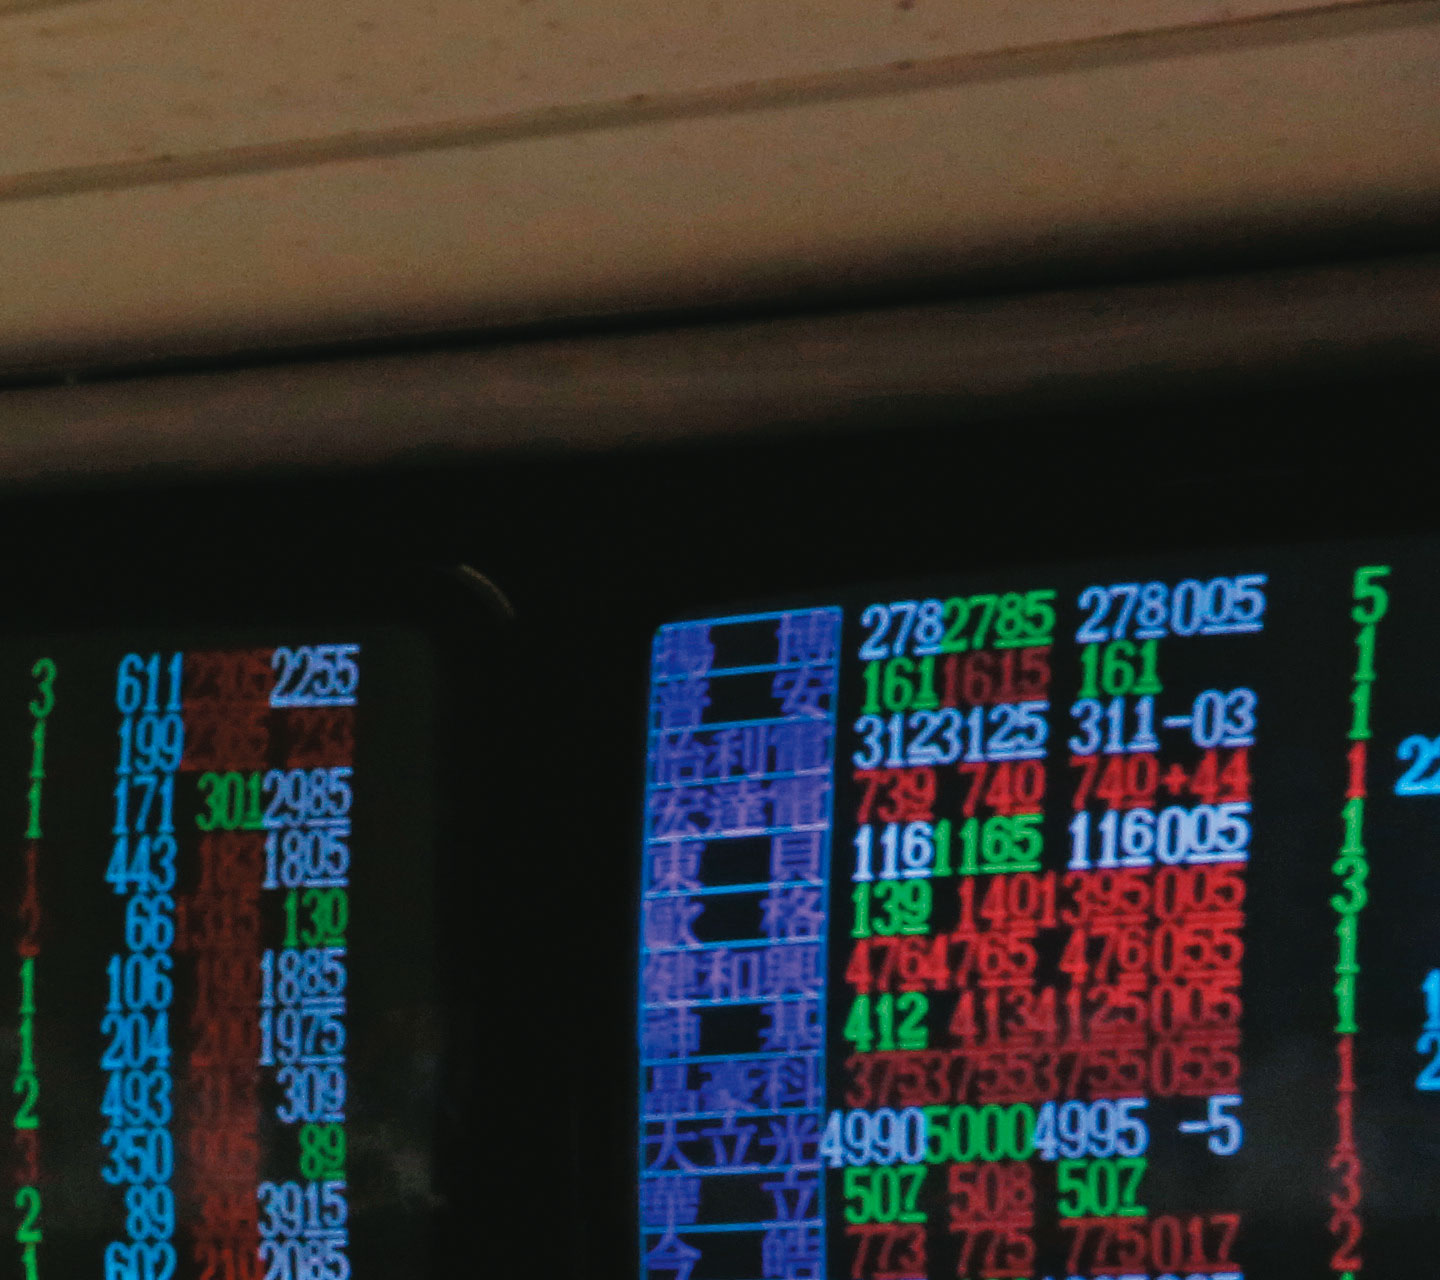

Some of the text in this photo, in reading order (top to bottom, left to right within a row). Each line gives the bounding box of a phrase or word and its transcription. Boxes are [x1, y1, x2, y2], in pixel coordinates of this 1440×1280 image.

[859, 567, 1389, 659] 278 2785 5
[116, 646, 358, 712] 611 2255
[862, 640, 1162, 713] 161 161
[117, 715, 183, 773] 199
[113, 769, 352, 833] 171 2985
[104, 831, 349, 892] 443 1805
[854, 816, 1042, 881] 116 1165
[126, 889, 347, 951] 66 130
[851, 857, 1368, 936] 139 3
[106, 955, 172, 1010] 106
[258, 949, 346, 1008] 1885
[101, 1013, 170, 1067] 204
[844, 995, 929, 1051] 412
[101, 1065, 345, 1124] 493 309
[101, 1127, 173, 1184] 350
[819, 1108, 927, 1166] 4990
[924, 1104, 1036, 1161] 5000
[1034, 1098, 1147, 1158] 4995
[126, 1187, 173, 1242] 89
[844, 1158, 1146, 1223] 507 507
